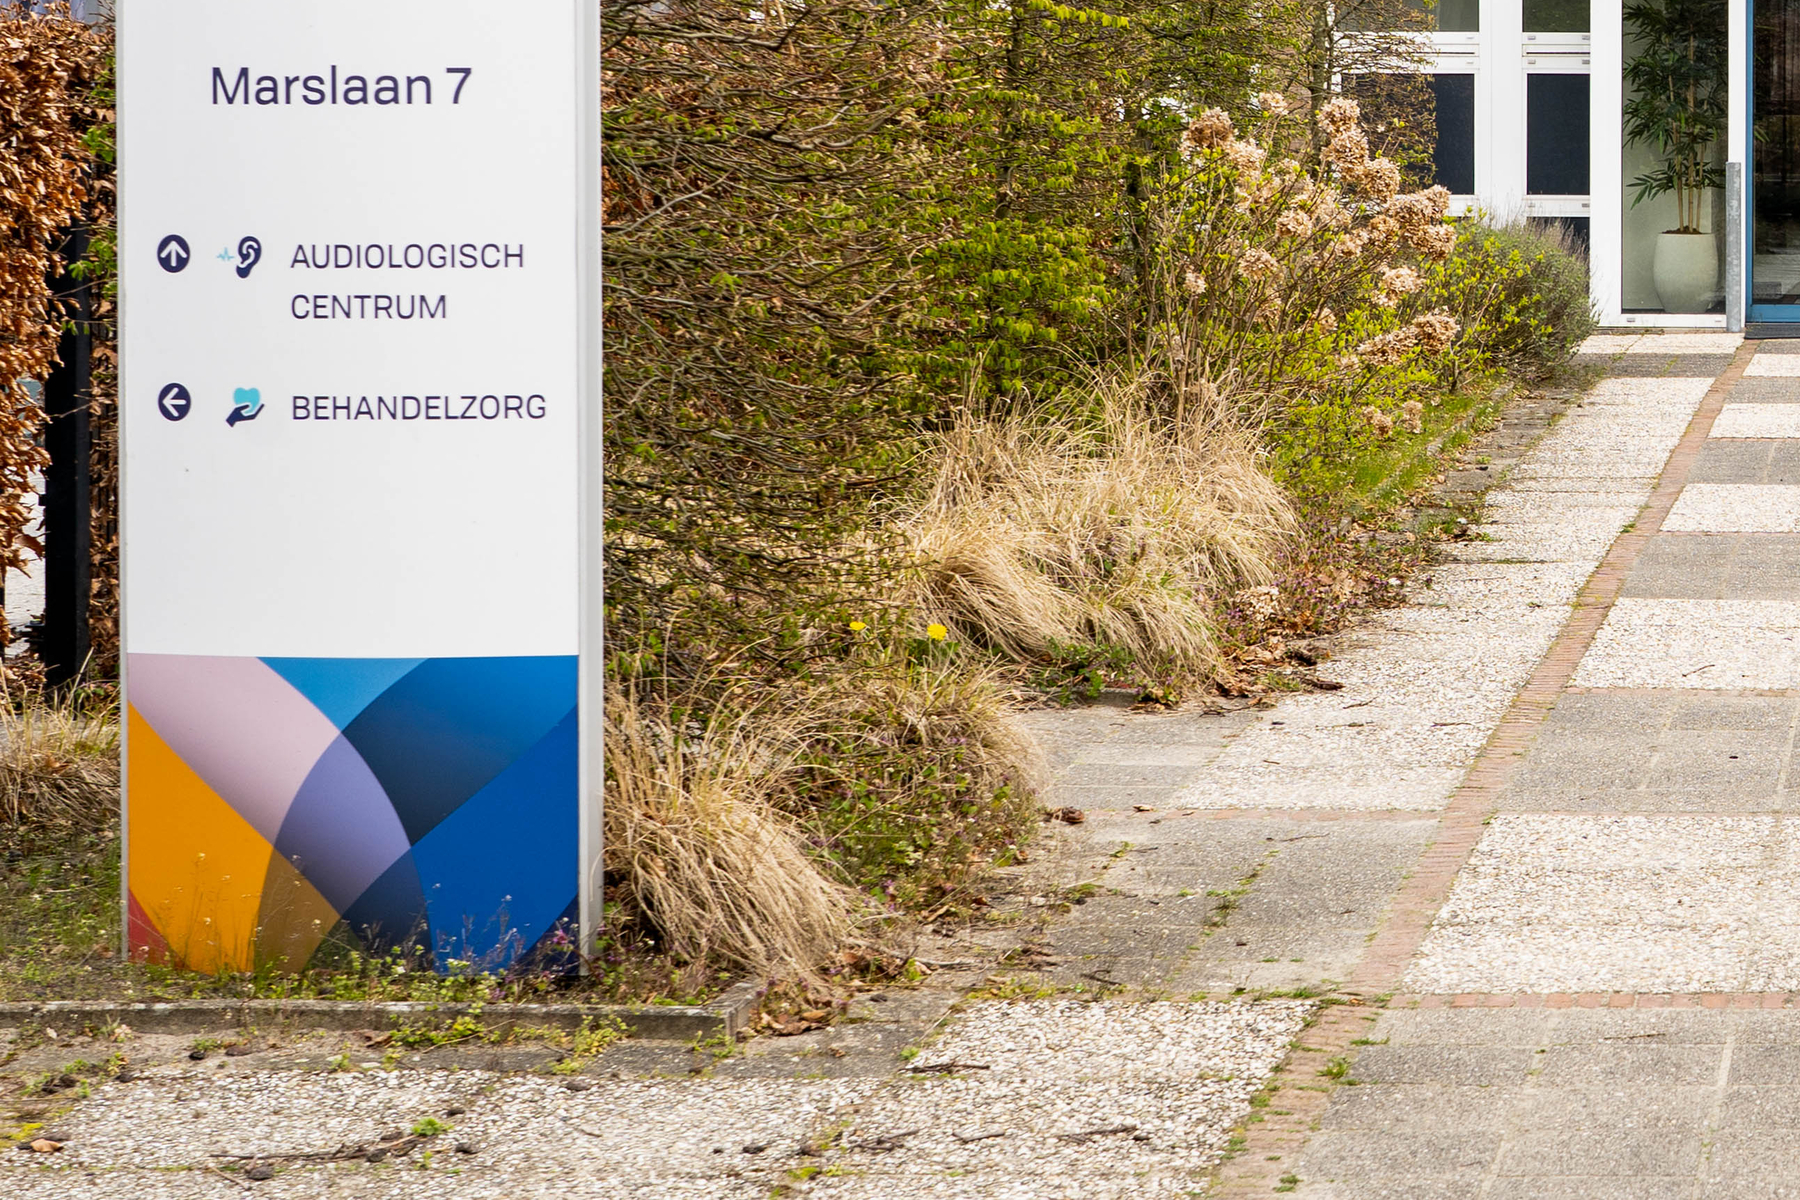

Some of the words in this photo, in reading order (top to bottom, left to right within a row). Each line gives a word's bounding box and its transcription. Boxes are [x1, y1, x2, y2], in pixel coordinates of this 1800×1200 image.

[211, 64, 432, 106] Marslaan
[446, 67, 473, 105] 7
[290, 243, 524, 270] AUDIOLOGISCH
[290, 294, 447, 320] CENTRUM
[292, 394, 547, 421] BEHANDELZORG
